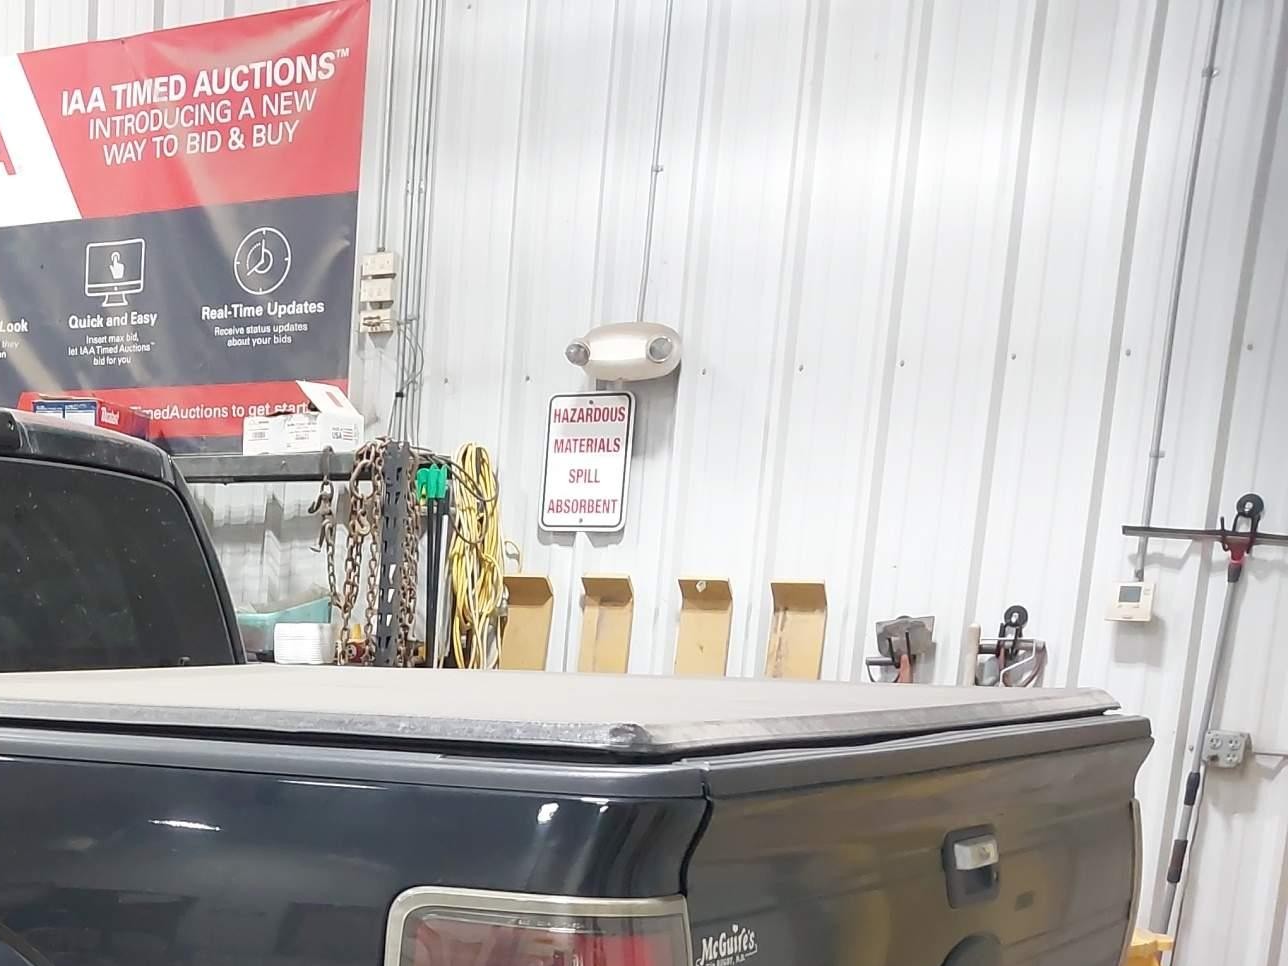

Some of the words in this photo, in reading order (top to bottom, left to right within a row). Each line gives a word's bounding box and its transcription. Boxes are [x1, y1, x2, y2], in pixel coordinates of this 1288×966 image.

[61, 86, 106, 116] IAA
[111, 74, 187, 109] TIMED
[88, 99, 232, 140] INTRODUCING
[237, 97, 256, 121] A
[261, 87, 317, 117] NEW
[103, 138, 147, 166] WAY
[151, 134, 179, 157] TO
[185, 130, 222, 154] BID
[227, 127, 246, 150] &
[252, 120, 300, 148] BUY
[201, 303, 264, 320] Real-Time
[267, 300, 325, 318] Updates
[0, 319, 28, 332] Look
[68, 314, 104, 329] Quick
[105, 312, 128, 327] and
[130, 311, 158, 326] Easy
[214, 326, 245, 336] Receive
[246, 324, 271, 334] status
[273, 322, 309, 334] updates
[86, 335, 107, 344] Insert
[108, 335, 125, 344] max
[227, 336, 251, 347] about
[252, 337, 272, 347] your
[273, 335, 292, 345] bids
[79, 346, 95, 356] IAA
[96, 344, 119, 354] Timed
[93, 356, 106, 366] bid
[106, 355, 117, 365] for
[117, 356, 132, 366] you
[231, 405, 245, 418] to
[248, 402, 271, 418] get
[553, 406, 626, 423] HAZARDOUS
[553, 437, 621, 454] MATERIALS
[568, 468, 601, 484] SPILL
[547, 498, 618, 514] ABSORBENT
